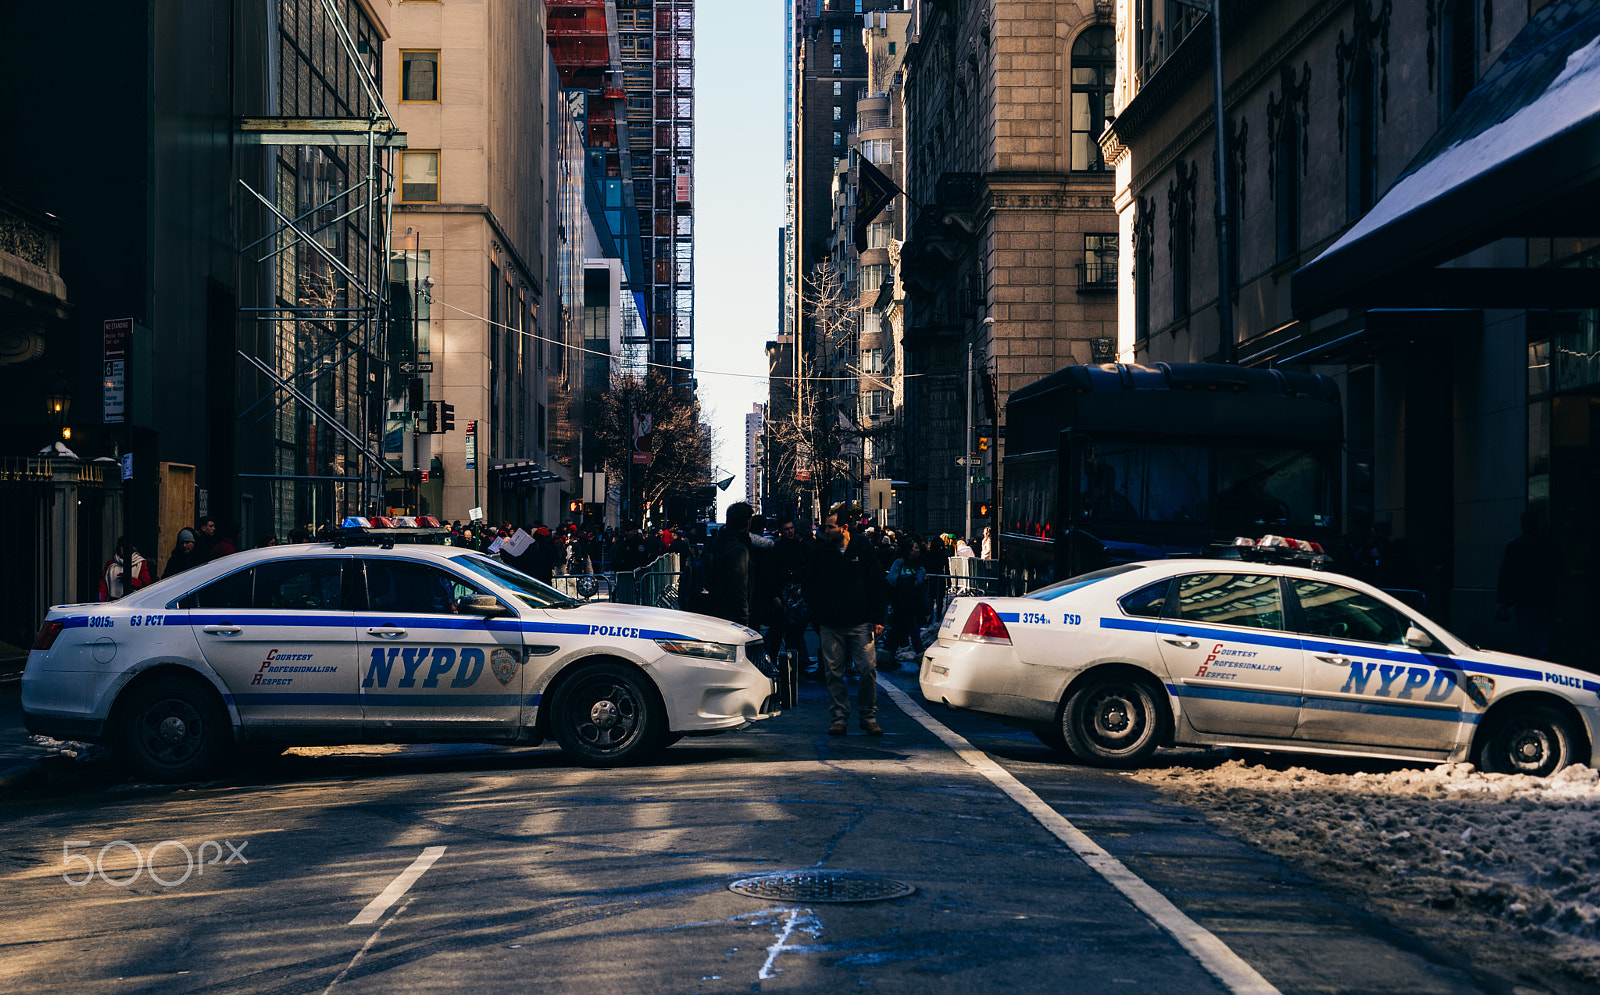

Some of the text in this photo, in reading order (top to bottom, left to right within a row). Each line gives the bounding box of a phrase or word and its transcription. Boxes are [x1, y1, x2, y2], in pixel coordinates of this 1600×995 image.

[106, 363, 111, 375] 6
[89, 616, 110, 627] 3015
[130, 615, 163, 626] 63 PCT
[1023, 613, 1045, 624] 3754
[1063, 614, 1081, 625] FSD
[591, 625, 638, 638] POLICE
[267, 649, 313, 660] COURTESY
[1212, 644, 1258, 658] COURTESY
[259, 661, 337, 672] PROFESSIONALISM
[362, 648, 485, 688] NYPD
[1204, 655, 1282, 671] PROFESSIONALISM
[1195, 666, 1237, 679] RESPECT
[251, 674, 293, 685] RESPECT
[1340, 662, 1457, 702] NYPD
[1545, 673, 1581, 688] POLICE
